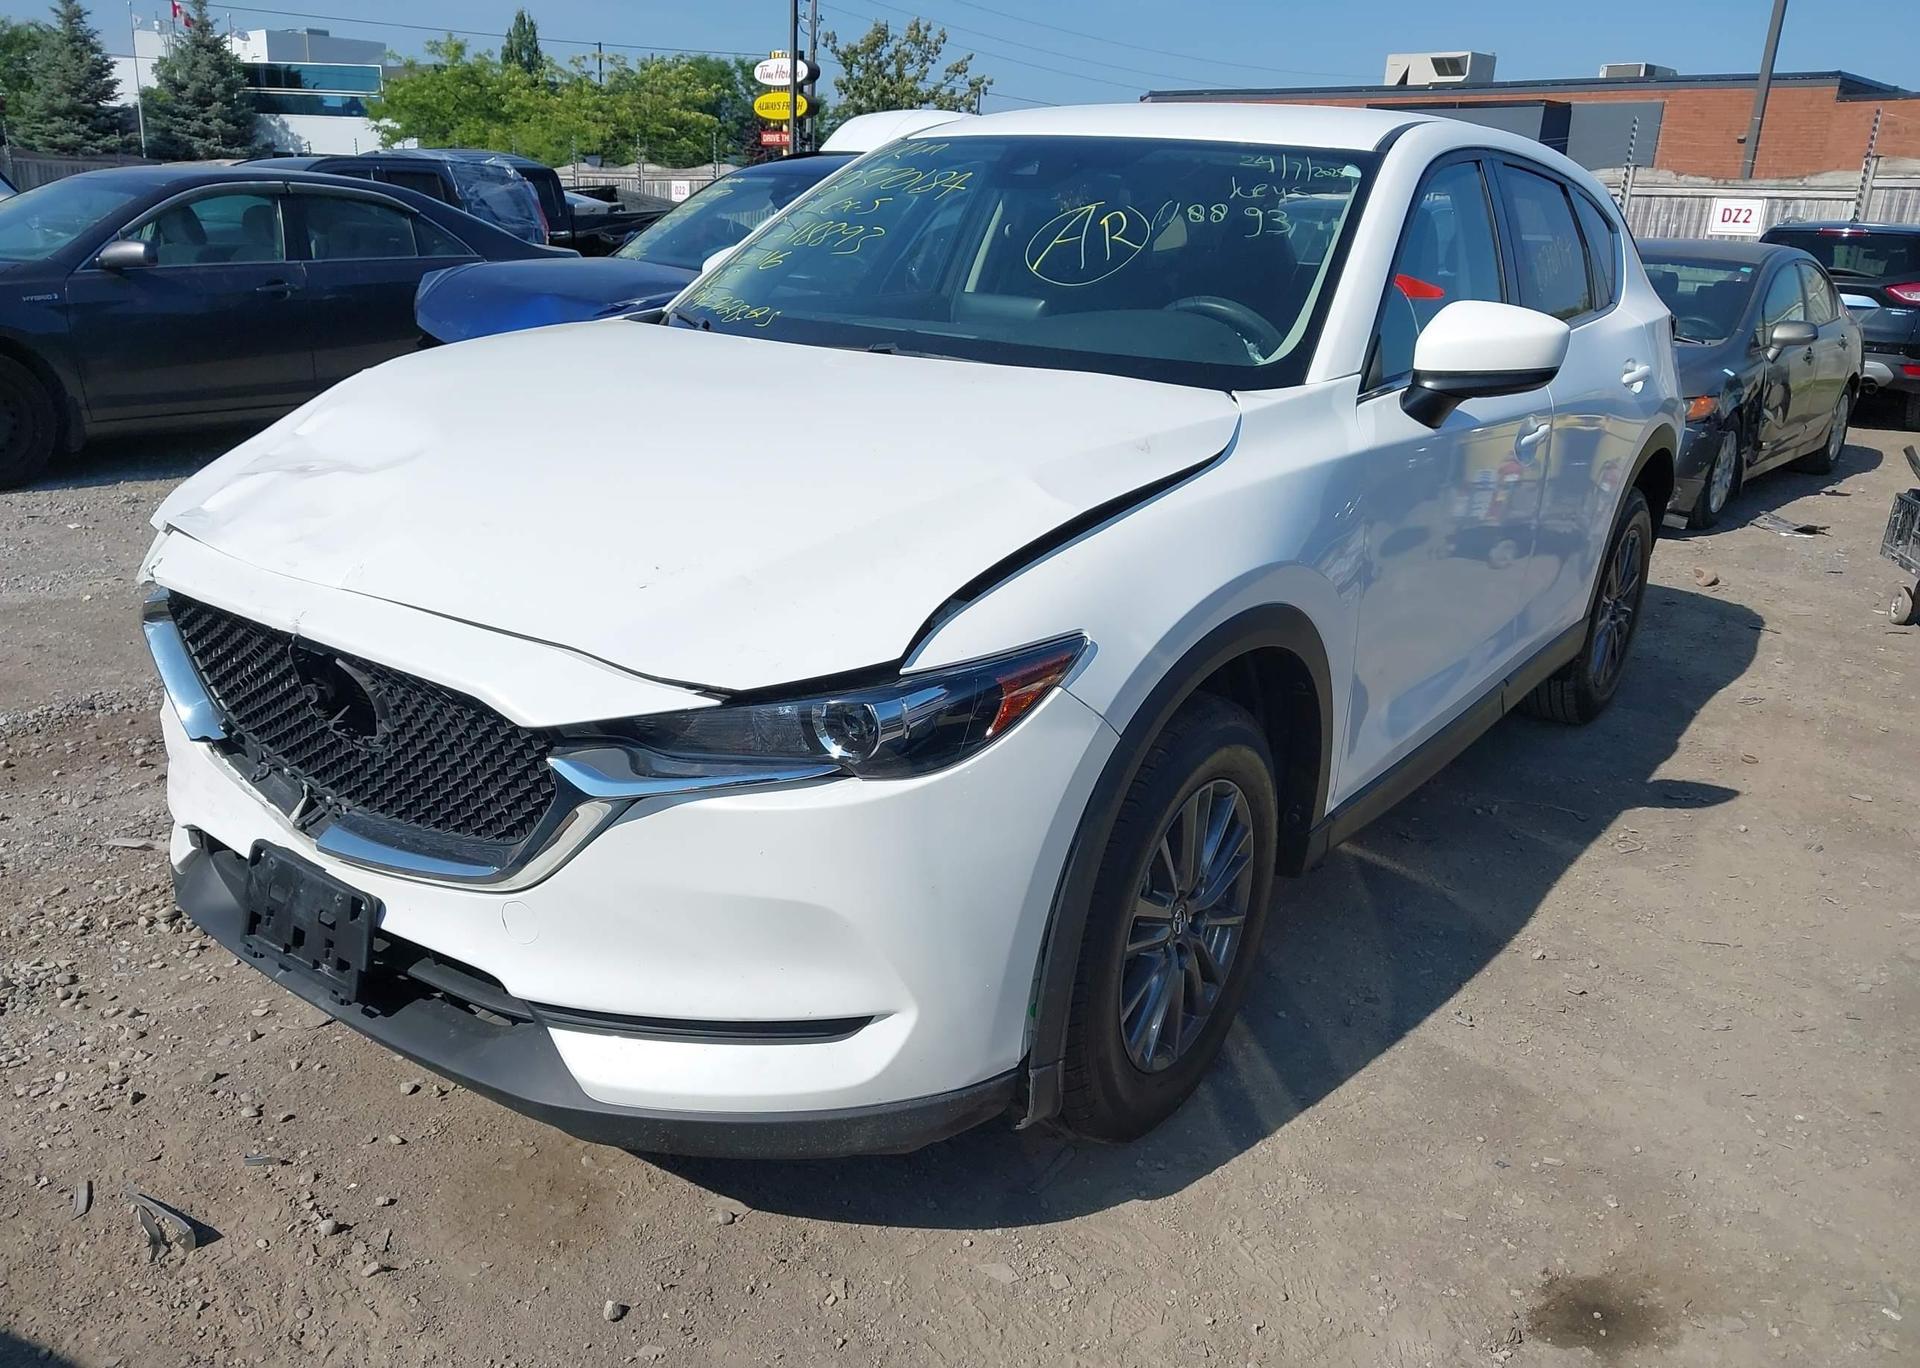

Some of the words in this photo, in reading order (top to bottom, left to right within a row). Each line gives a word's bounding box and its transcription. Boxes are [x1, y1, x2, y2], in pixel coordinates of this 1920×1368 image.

[758, 101, 780, 111] ALWAYS
[781, 101, 804, 111] FRH
[762, 134, 780, 142] DRIVE
[1721, 207, 1752, 223] DZ2
[1032, 200, 1143, 270] AR
